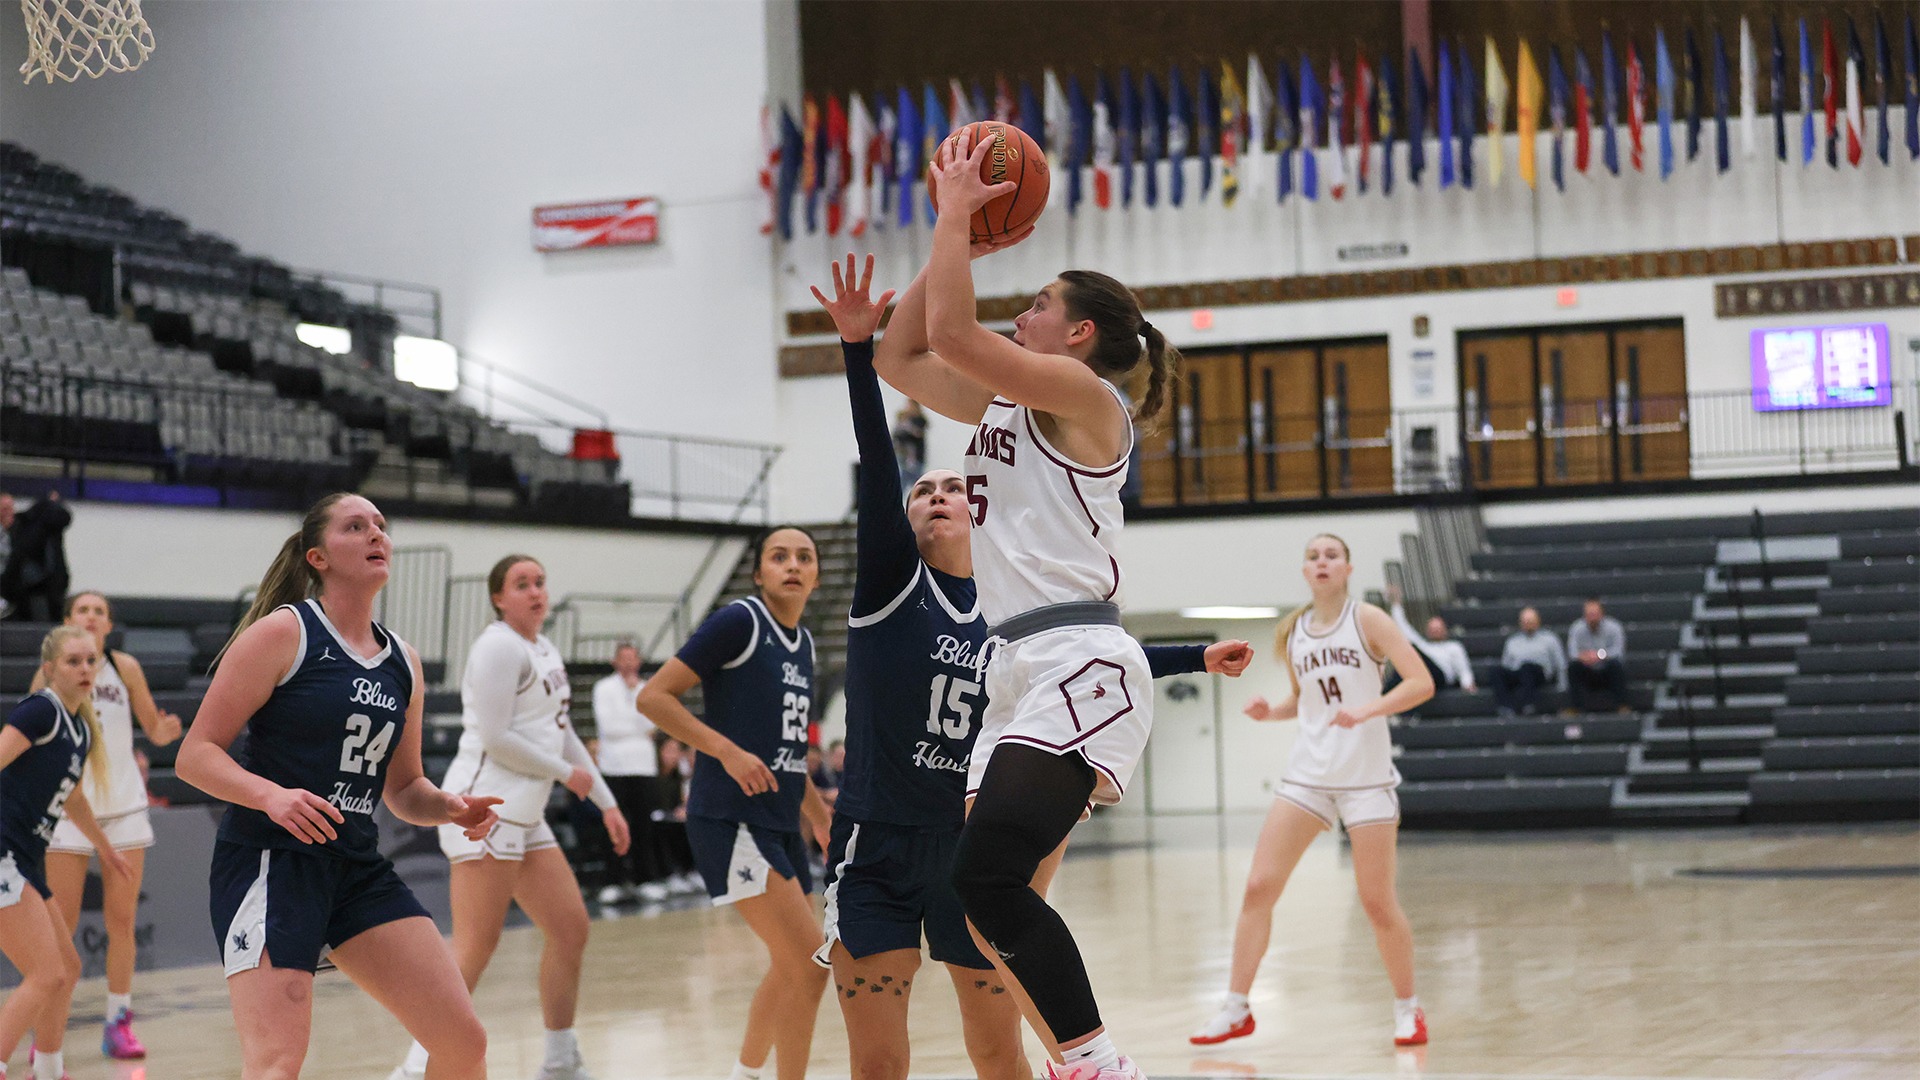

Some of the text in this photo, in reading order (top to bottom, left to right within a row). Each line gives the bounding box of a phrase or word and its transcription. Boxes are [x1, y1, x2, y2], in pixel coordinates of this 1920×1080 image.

[986, 125, 1007, 186] PALDIN
[930, 634, 988, 673] Blue
[349, 677, 397, 711] Blue
[926, 673, 982, 740] 15
[1317, 676, 1343, 706] 14
[782, 691, 811, 743] 23
[339, 713, 396, 777] 24
[912, 741, 971, 773] Hawk
[327, 781, 374, 816] Hawks
